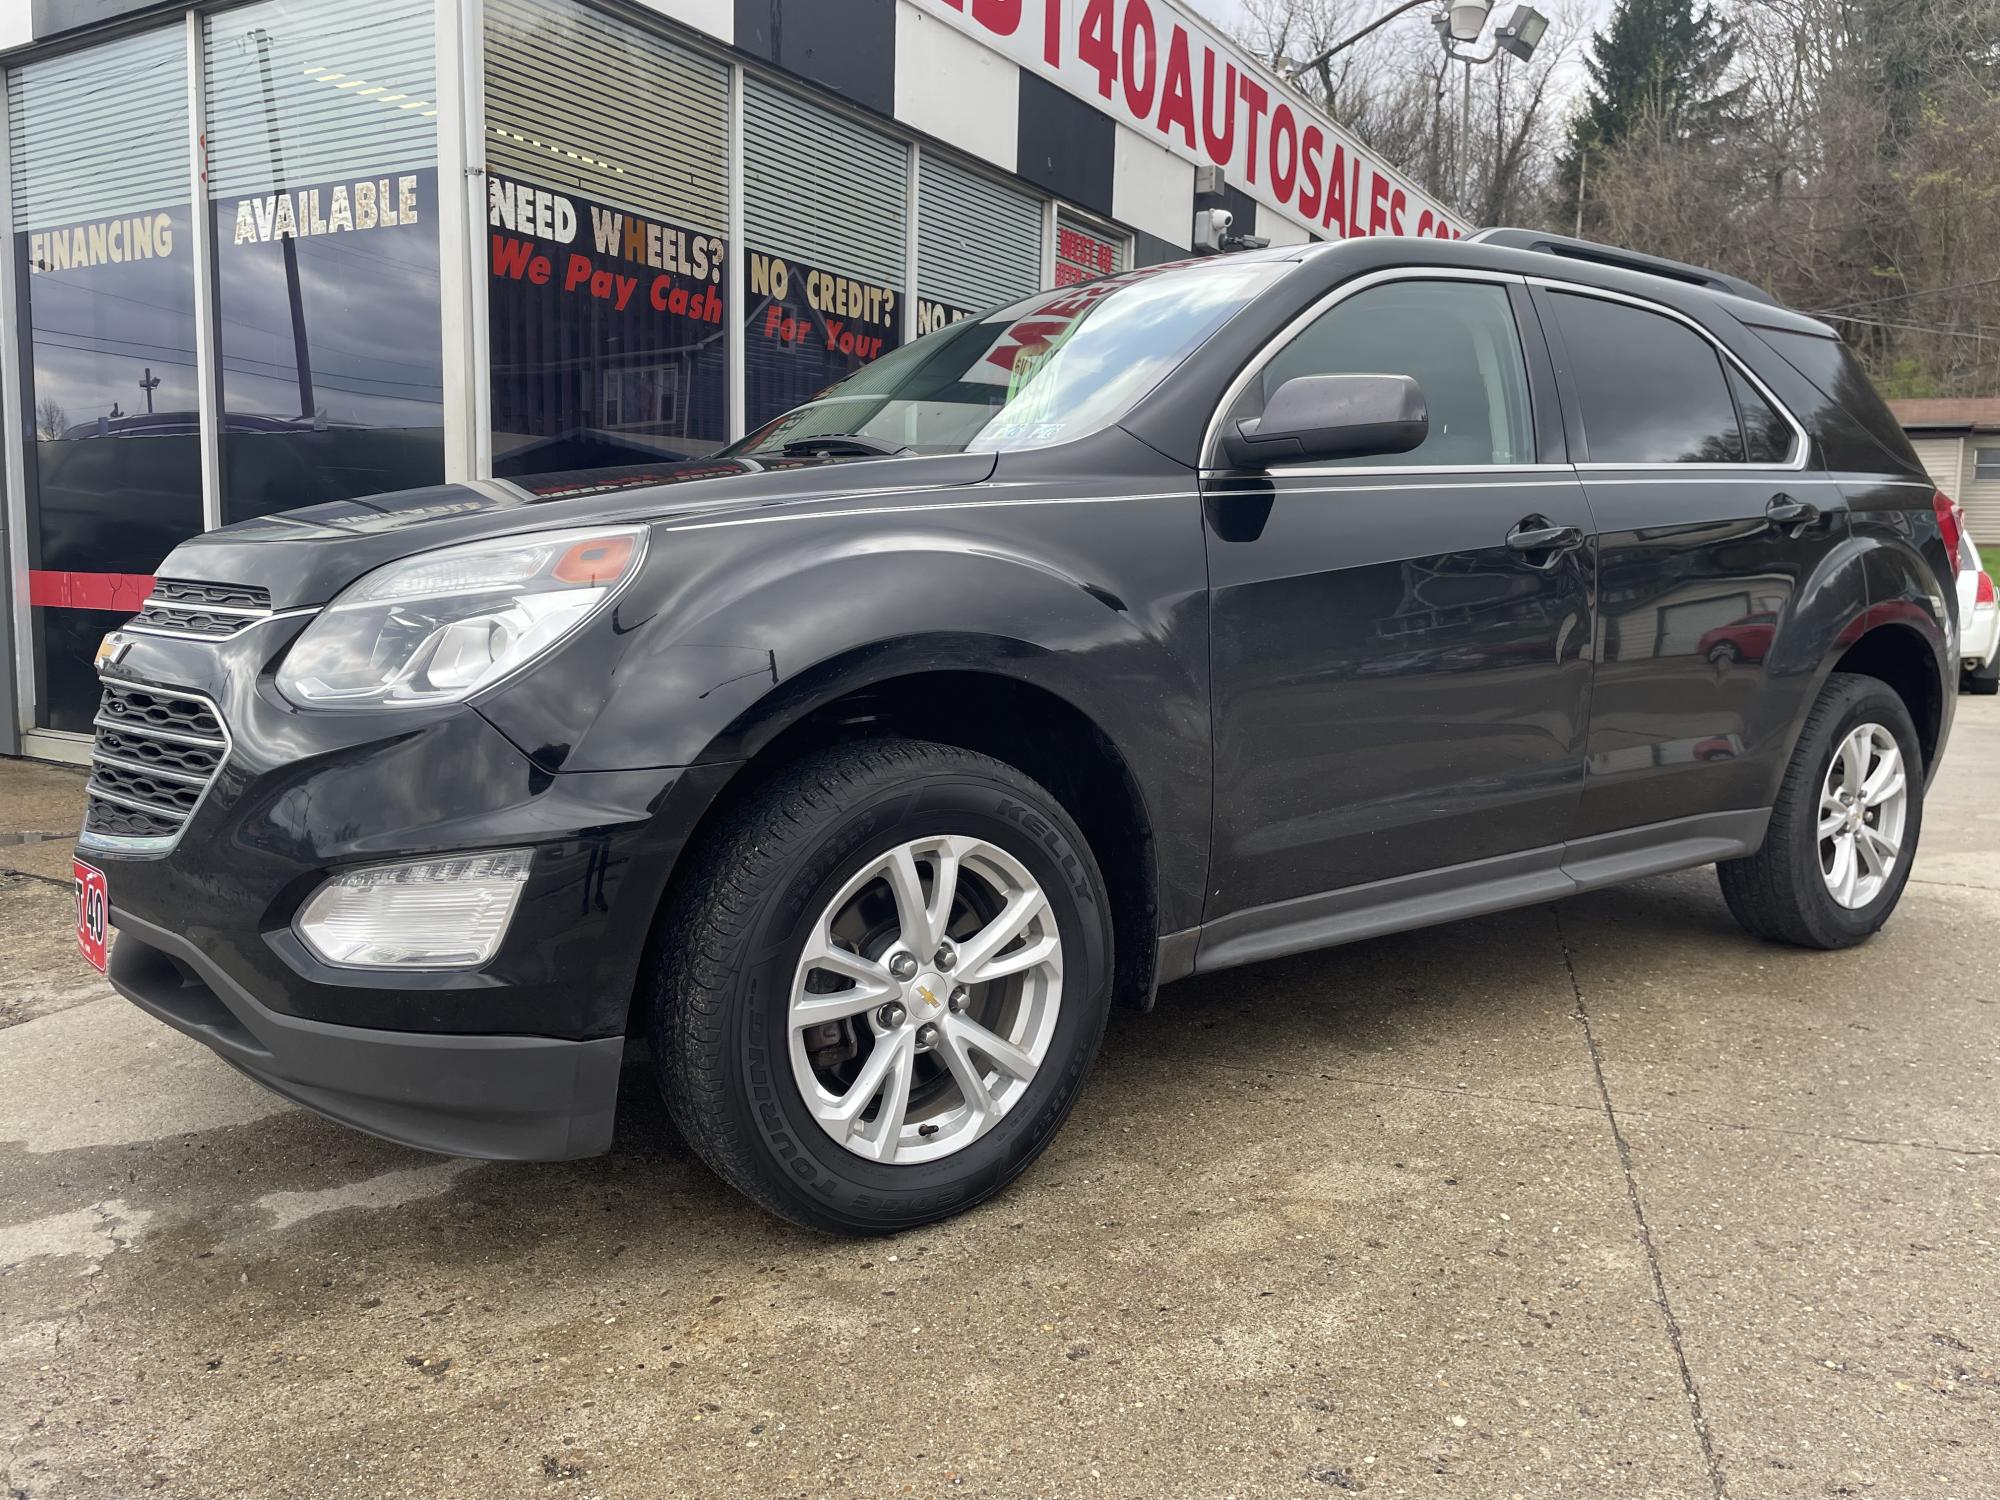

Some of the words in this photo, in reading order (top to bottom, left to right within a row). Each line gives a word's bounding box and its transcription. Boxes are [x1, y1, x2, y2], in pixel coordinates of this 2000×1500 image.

[31, 213, 172, 274] FINANCING
[233, 175, 418, 245] AVAILABLE
[489, 177, 577, 244] NEED
[590, 206, 725, 284] WHEELS?
[492, 234, 552, 285] We
[565, 253, 638, 311] Pay
[650, 275, 723, 324] Cash
[1060, 228, 1095, 267] WEST
[751, 253, 787, 300] NO
[806, 270, 894, 328] CREDIT?
[919, 300, 946, 335] NO
[764, 305, 811, 344] For
[826, 321, 882, 360] Your
[994, 799, 1094, 905] KELLY
[749, 1012, 838, 1197] TOURING
